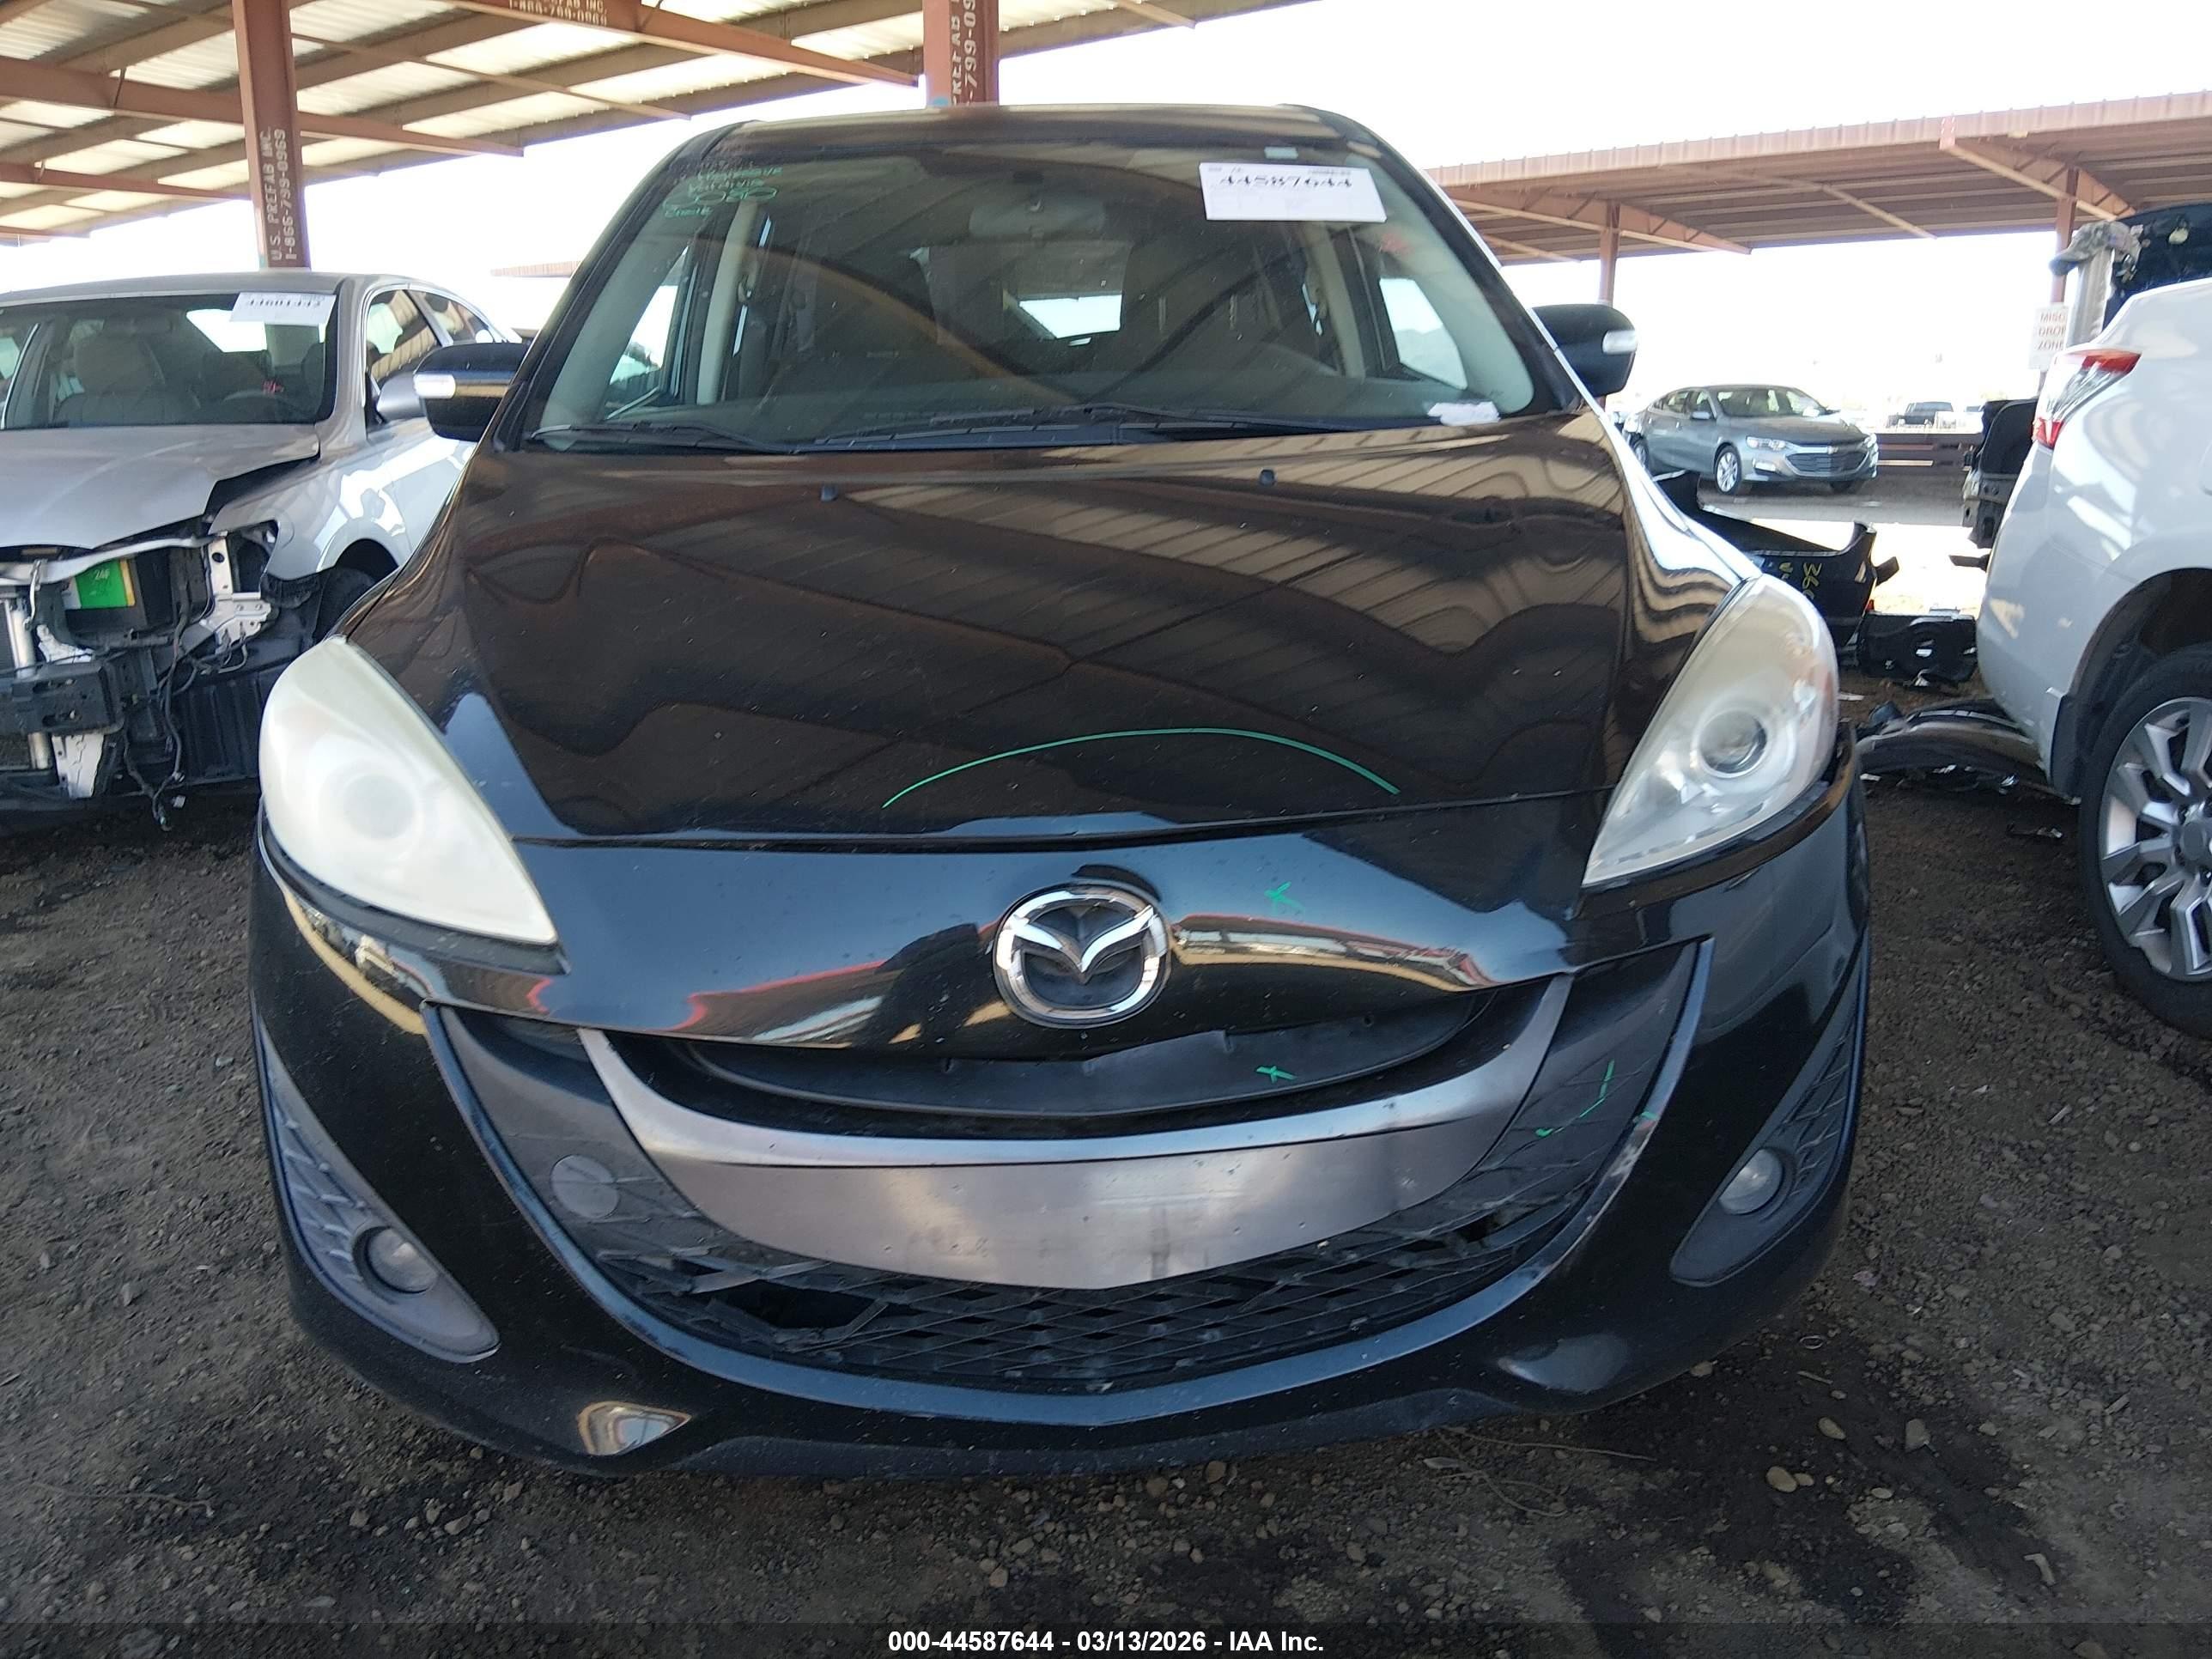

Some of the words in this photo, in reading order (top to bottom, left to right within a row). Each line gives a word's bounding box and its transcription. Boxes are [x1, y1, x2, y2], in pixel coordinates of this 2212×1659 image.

[951, 15, 962, 106] REFAB
[262, 162, 279, 224] PREFAB
[274, 129, 297, 260] 1-866-799-0969
[1218, 174, 1352, 188] 44587644
[269, 229, 283, 261] U.S.
